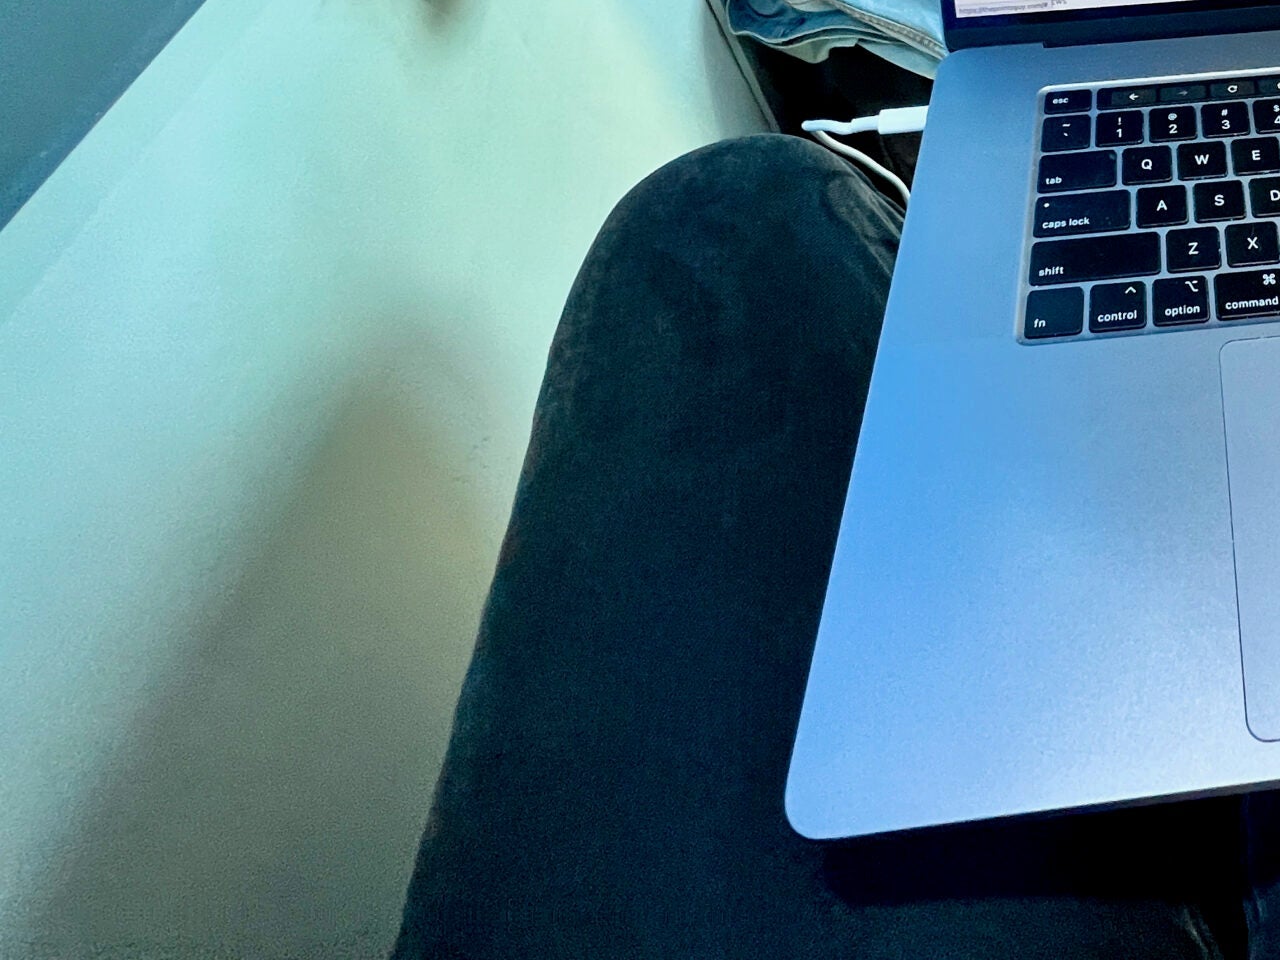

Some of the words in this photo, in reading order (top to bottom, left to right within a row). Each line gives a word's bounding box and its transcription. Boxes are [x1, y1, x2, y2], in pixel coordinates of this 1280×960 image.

[1052, 97, 1069, 105] esc
[1045, 176, 1063, 185] tab
[1042, 219, 1067, 229] caps
[1068, 216, 1090, 226] lock
[1188, 242, 1199, 255] Z
[1247, 236, 1259, 250] X
[1038, 266, 1064, 277] shift
[1225, 296, 1279, 310] command
[1097, 310, 1138, 322] control
[1164, 304, 1201, 317] option
[1033, 318, 1046, 328] fn
